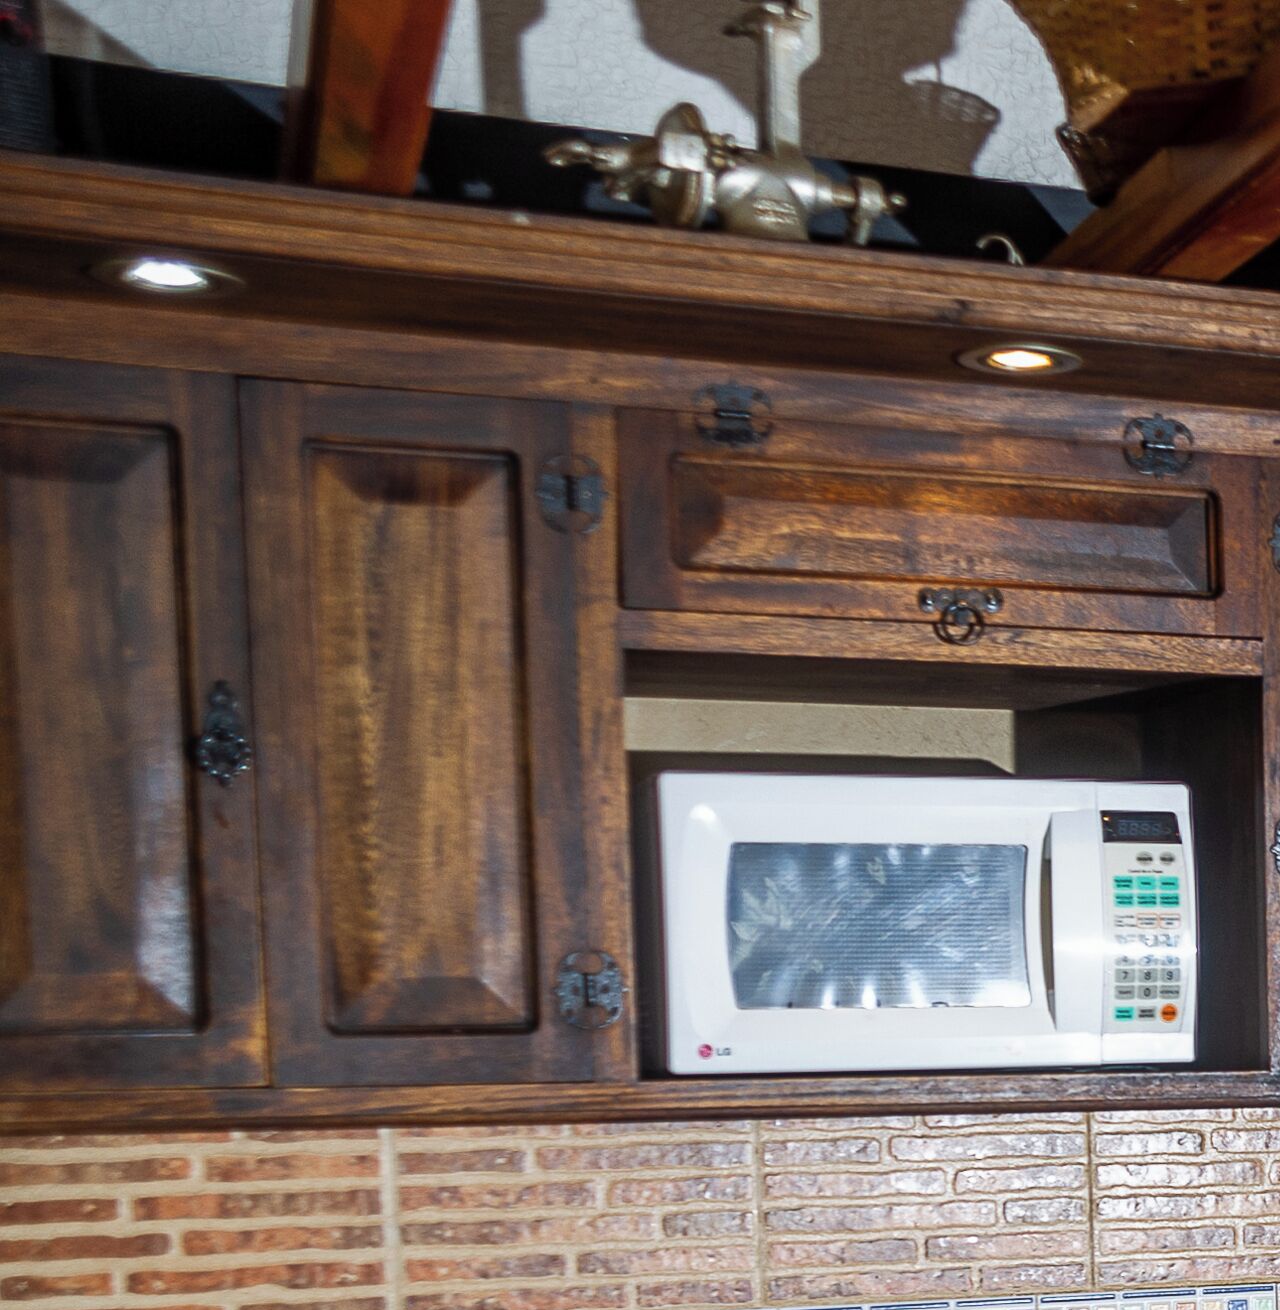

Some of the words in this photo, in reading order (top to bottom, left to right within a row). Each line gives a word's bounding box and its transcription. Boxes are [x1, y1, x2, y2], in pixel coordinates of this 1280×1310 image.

[1121, 971, 1129, 980] 7
[1144, 971, 1152, 981] 8
[1166, 971, 1174, 981] 9
